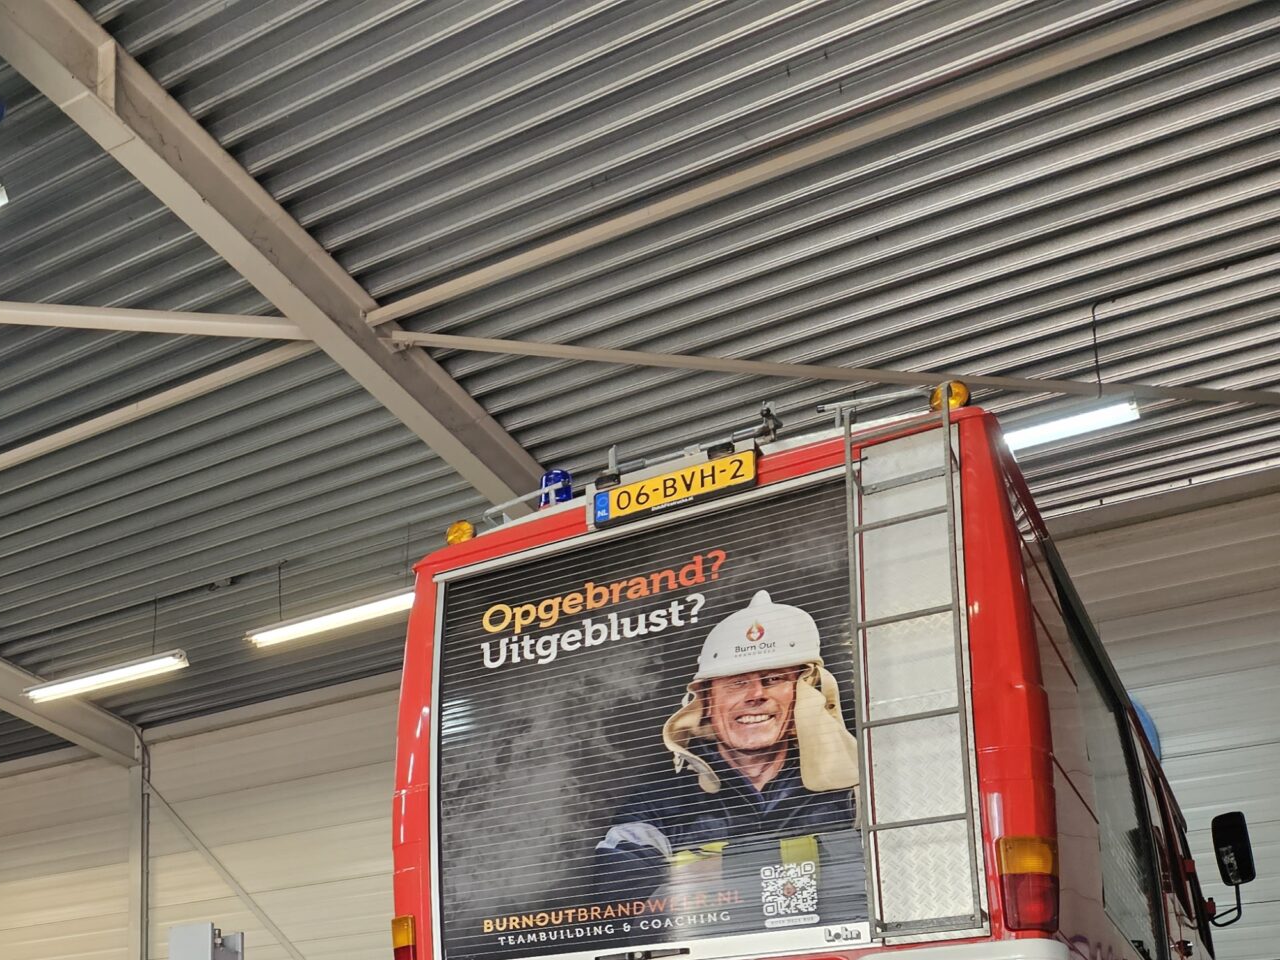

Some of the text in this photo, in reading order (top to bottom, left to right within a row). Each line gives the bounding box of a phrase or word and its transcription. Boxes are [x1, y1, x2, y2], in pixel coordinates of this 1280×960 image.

[616, 458, 745, 511] 06-BVH-2
[482, 549, 728, 634] Opgebrand?
[480, 592, 706, 669] Uitgeblust?
[734, 641, 776, 654] Burn Out
[497, 911, 732, 947] TEAMBUILDING & COACHING
